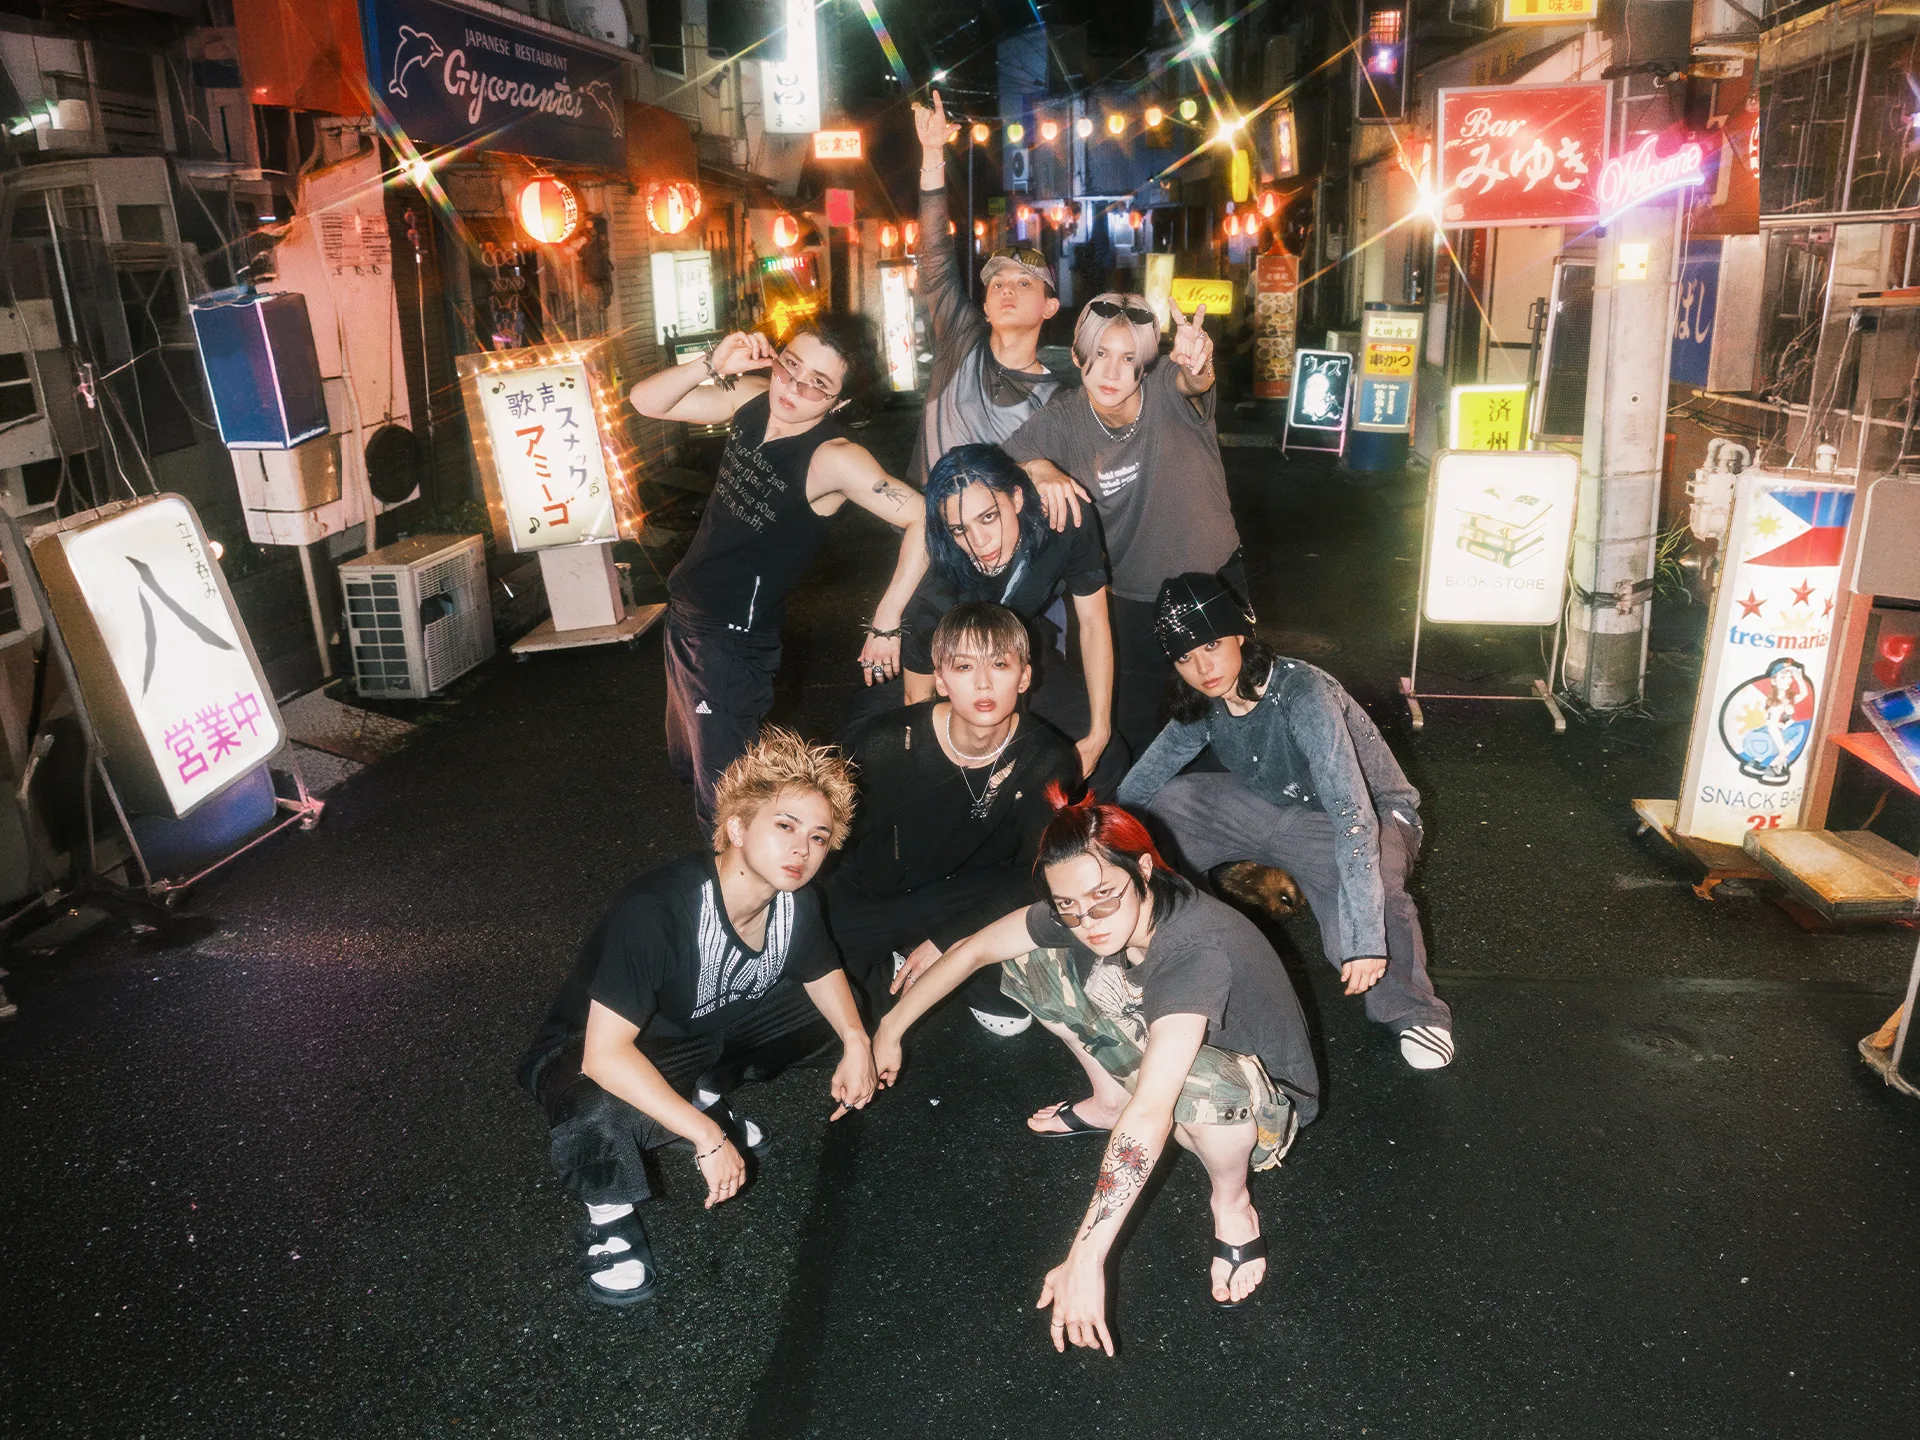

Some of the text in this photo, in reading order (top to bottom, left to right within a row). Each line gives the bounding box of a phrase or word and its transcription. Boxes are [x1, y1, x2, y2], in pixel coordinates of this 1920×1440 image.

[464, 27, 568, 72] JAPANESE RESTAURANT
[1459, 107, 1527, 138] Bar
[1455, 136, 1590, 195] みゆき
[1600, 135, 1702, 208] Welcome
[1178, 286, 1230, 304] Moon
[1369, 353, 1411, 368] 串かつ
[505, 382, 556, 419] 歌声
[555, 406, 588, 489] スナック
[515, 424, 575, 528] アミーゴ
[175, 521, 217, 599] 立ち呑み
[1445, 575, 1546, 590] BOOK STORE
[164, 691, 262, 785] 営業中
[1700, 785, 1777, 810] SNACK
